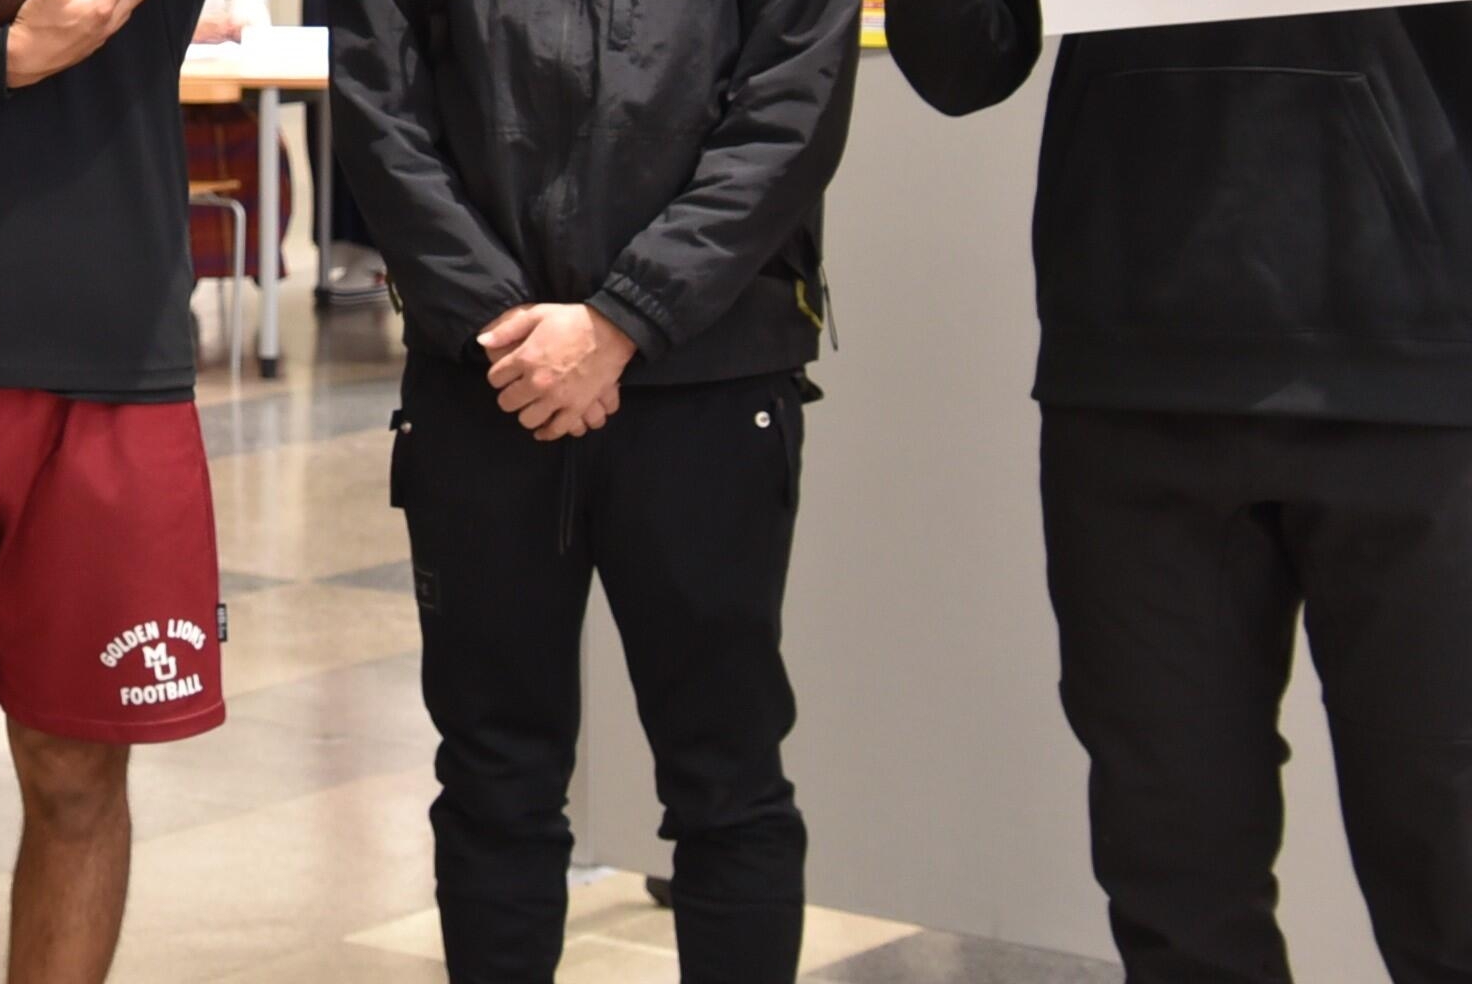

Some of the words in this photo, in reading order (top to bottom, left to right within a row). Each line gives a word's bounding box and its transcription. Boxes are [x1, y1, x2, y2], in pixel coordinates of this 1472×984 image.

[99, 620, 160, 668] GOLDEN
[167, 618, 207, 650] LIONS
[120, 673, 203, 706] FOOTBALL
